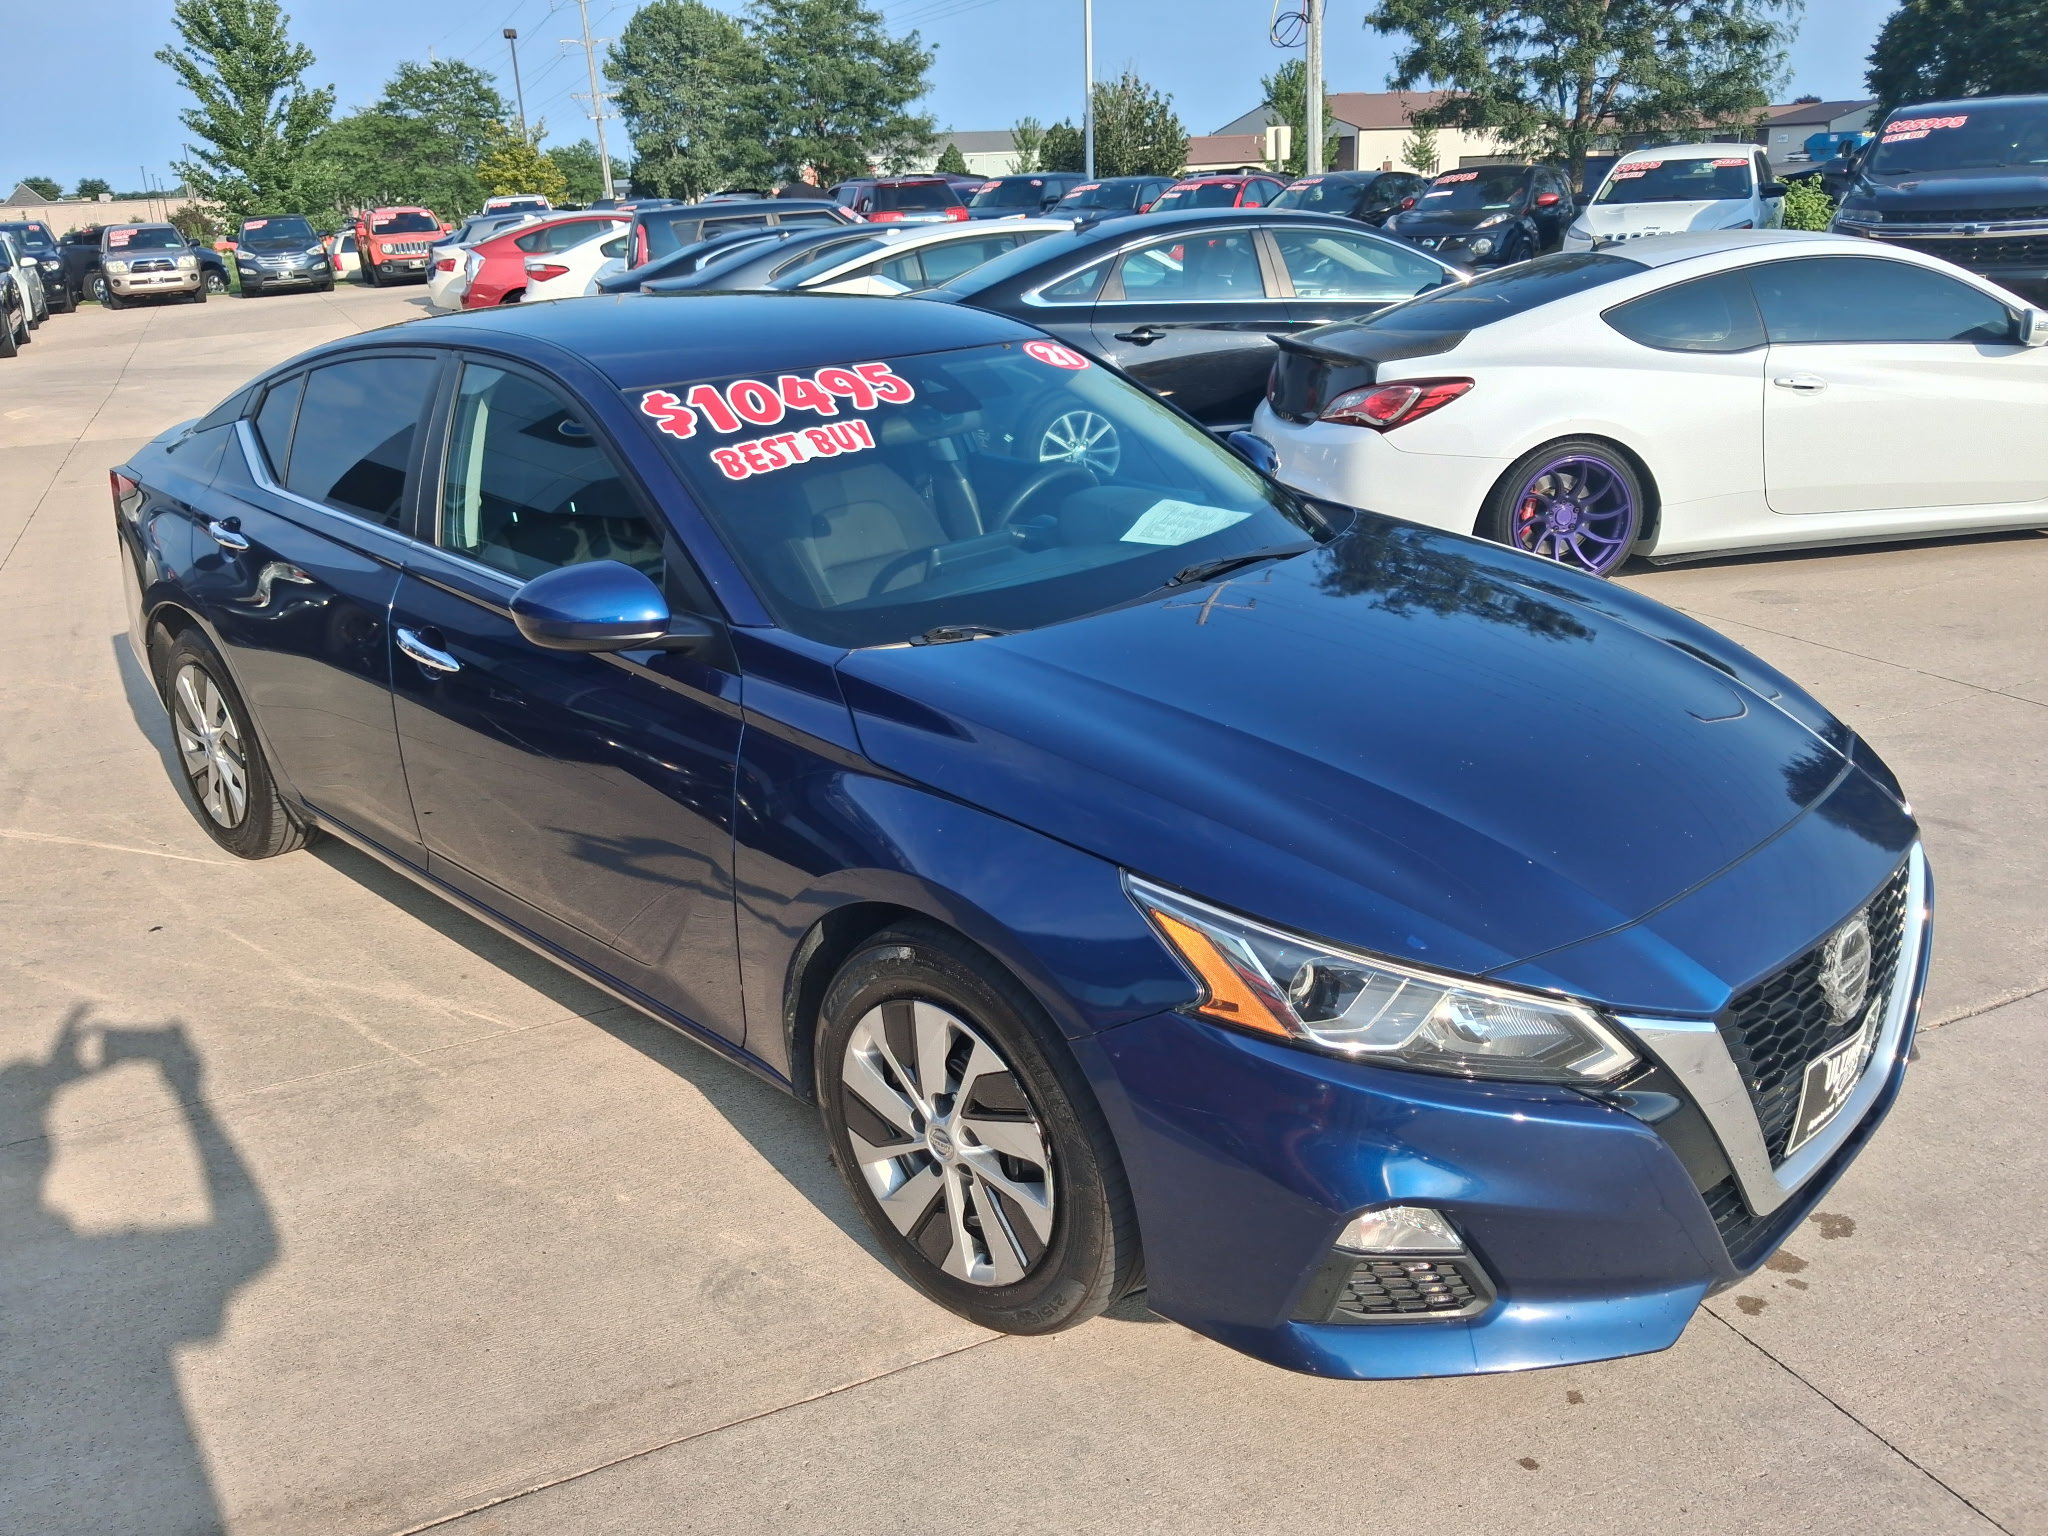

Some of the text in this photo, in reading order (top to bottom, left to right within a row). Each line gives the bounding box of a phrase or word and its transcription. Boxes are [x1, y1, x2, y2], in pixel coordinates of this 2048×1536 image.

[1885, 116, 1968, 133] $25995
[1881, 130, 1930, 144] BEST BUY
[1033, 345, 1081, 366] 21
[641, 362, 915, 439] $10495
[711, 419, 876, 480] BEST BUY
